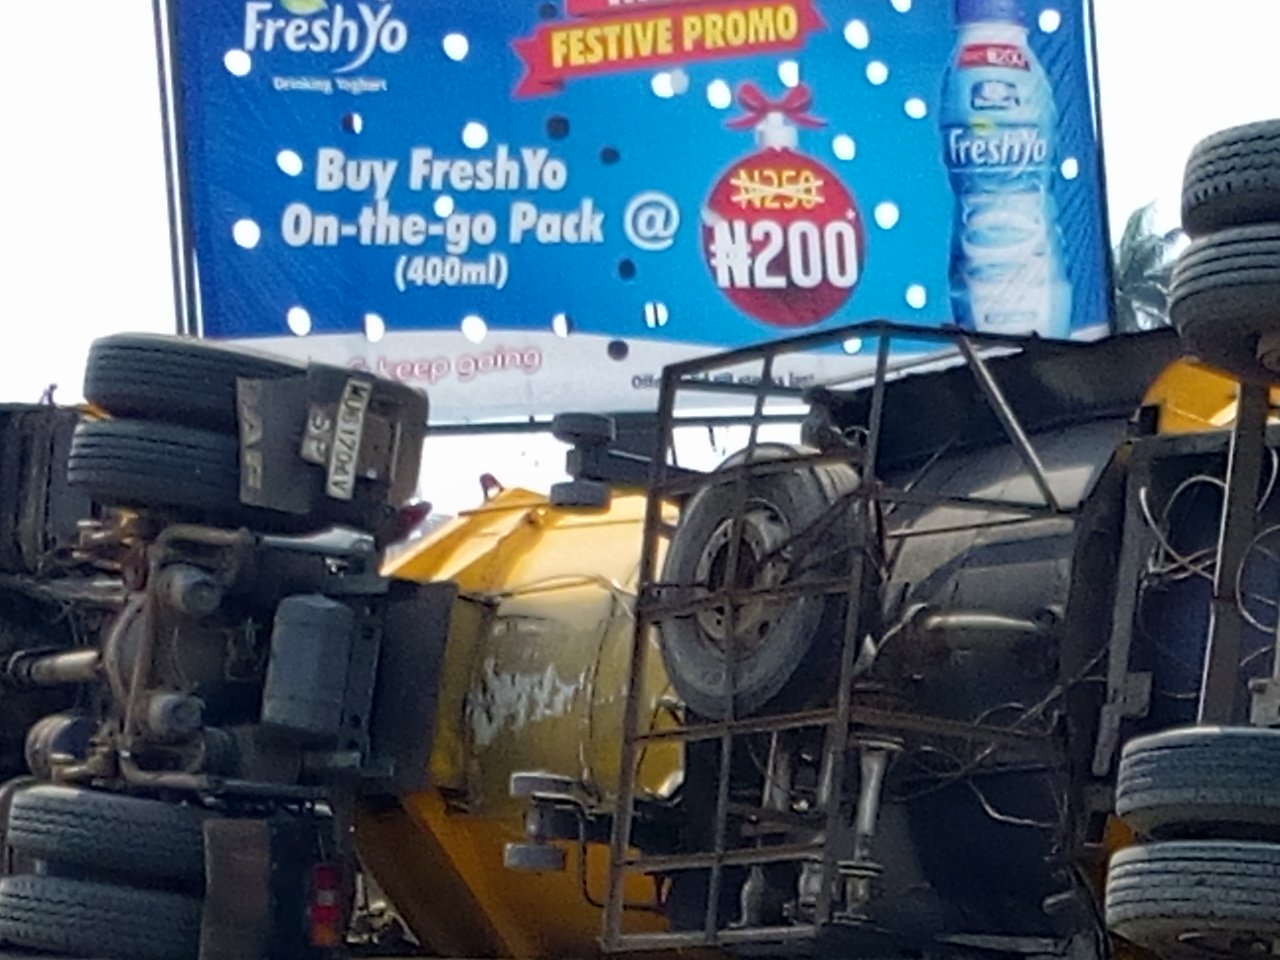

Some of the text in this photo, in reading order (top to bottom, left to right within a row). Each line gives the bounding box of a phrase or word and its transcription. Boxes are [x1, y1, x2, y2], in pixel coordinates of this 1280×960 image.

[244, 1, 408, 73] FreshYo
[551, 4, 799, 68] FESTIVE PROMO
[315, 143, 569, 200] Buy FreshYo
[950, 127, 1048, 178] FreshYo
[281, 190, 681, 254] On-the-go Pack @
[394, 252, 509, 292] (400ml)
[456, 345, 542, 382] going
